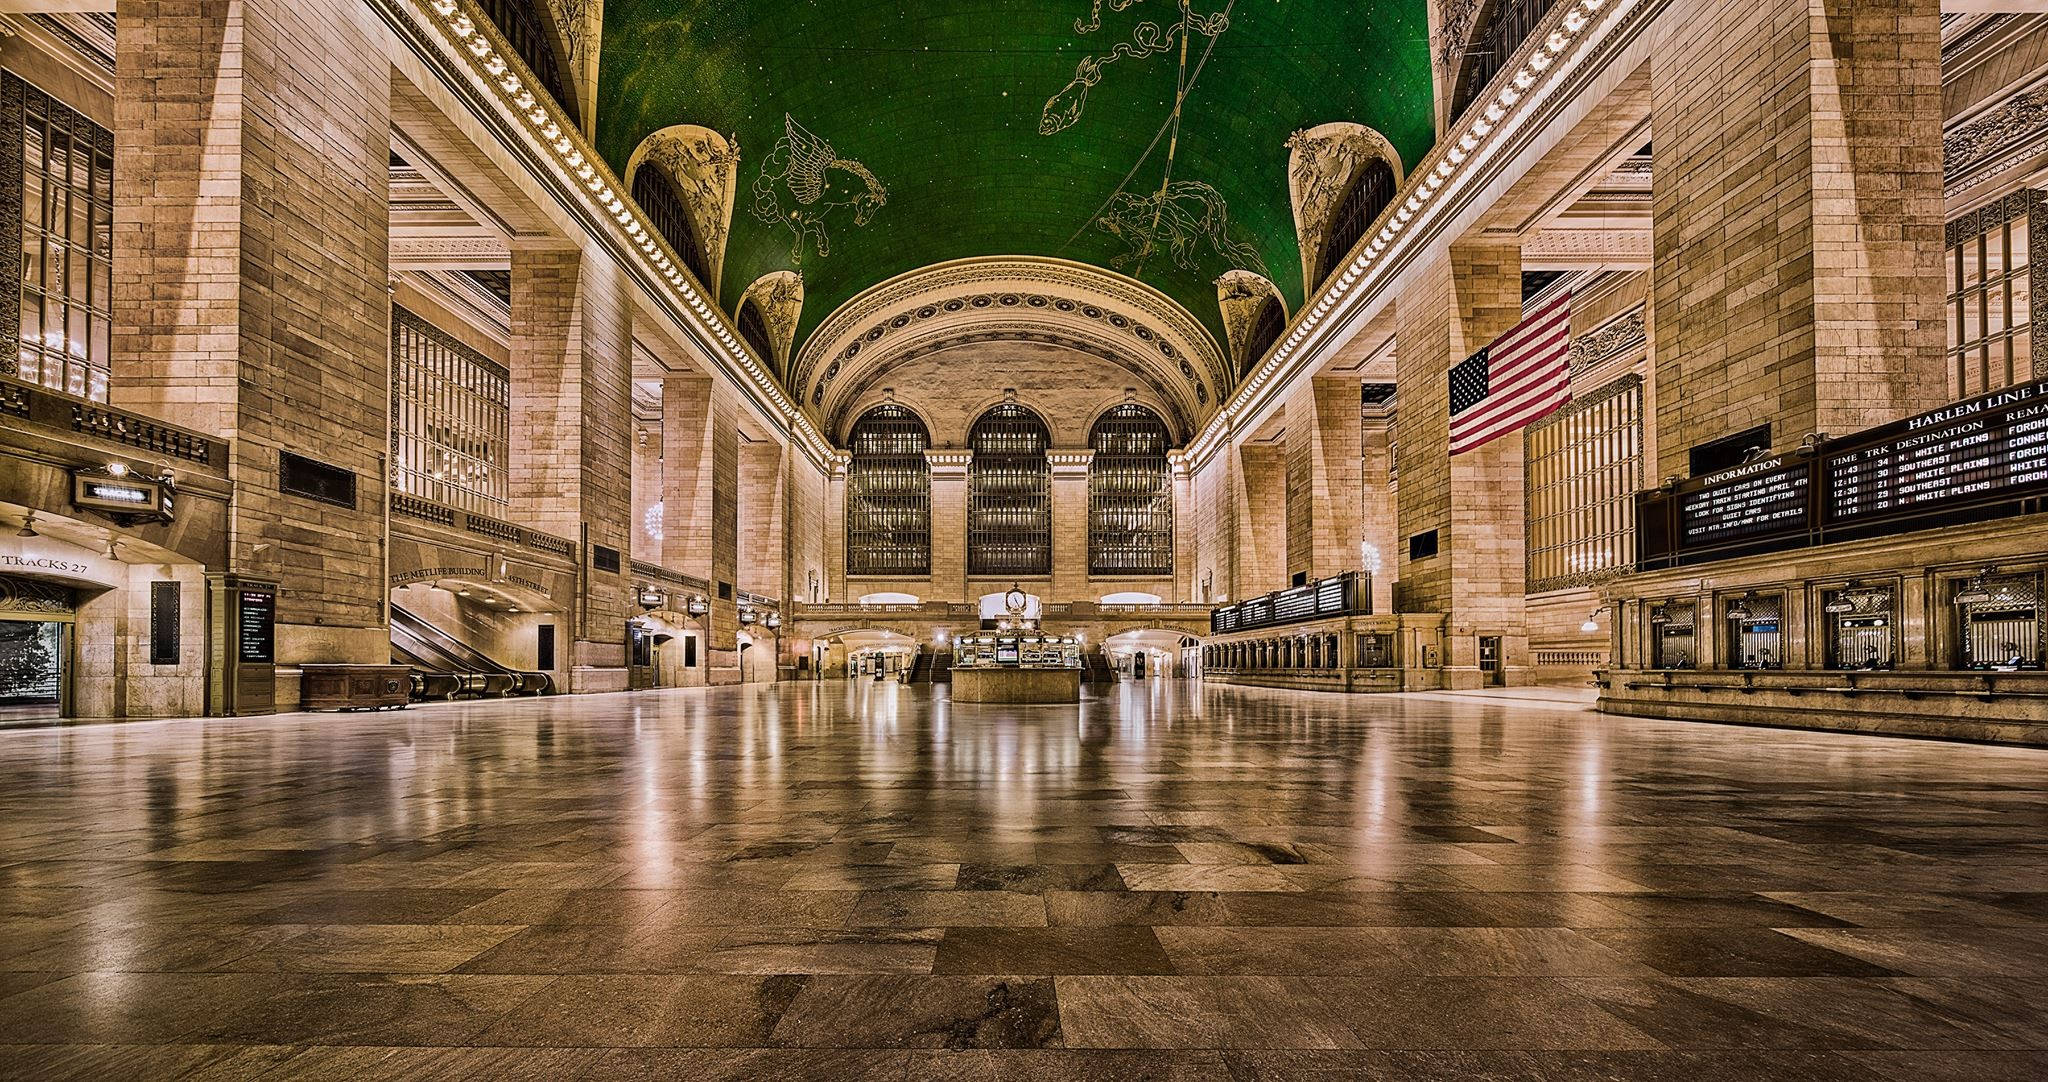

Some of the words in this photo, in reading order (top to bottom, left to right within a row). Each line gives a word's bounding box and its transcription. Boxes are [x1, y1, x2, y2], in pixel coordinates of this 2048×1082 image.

[1908, 401, 1981, 431] HARLEM
[1987, 387, 2032, 409] LINE
[1831, 453, 1858, 467] TIME
[1865, 445, 1889, 459] TRK
[1896, 420, 1984, 451] DESTINATION
[1834, 465, 1858, 477] 11:43
[1877, 458, 1889, 467] 34
[1915, 443, 1945, 458] WHITE
[1950, 433, 1989, 449] PLAINS
[1704, 457, 1782, 486] INFORMATION
[1833, 477, 1858, 488] 12:10
[1877, 469, 1889, 478] 30
[1898, 454, 1951, 473] SOUTHEAST
[2009, 431, 2048, 448] CONNE
[1833, 486, 1858, 498] 12:30
[1877, 479, 1888, 488] 21
[1915, 466, 1946, 480] WHITE
[1950, 457, 1990, 474] PLAINS
[2009, 445, 2048, 461] FORDH
[1684, 501, 1710, 512] WEEKDAY
[1712, 496, 1732, 506] TRAIN
[1734, 488, 1766, 501] STARTING
[1768, 482, 1790, 493] APRIL
[1794, 478, 1808, 487] 4TH
[1698, 492, 1710, 500] TWO
[1712, 487, 1732, 497] QUIET
[1734, 482, 1751, 492] CARS
[1753, 478, 1763, 487] ON
[1765, 473, 1787, 484] EVERY
[1838, 496, 1858, 507] 1:04
[1877, 490, 1889, 499] 29
[1898, 477, 1952, 495] SOUTHEAST
[2010, 457, 2047, 473] WHITE
[1694, 510, 1710, 518] LOOK
[1712, 507, 1724, 515] FOR
[1726, 502, 1746, 512] SIGNS
[1749, 490, 1795, 506] IDENTIFYING
[1722, 511, 1741, 521] QUIET
[1744, 507, 1762, 516] CARS
[1838, 506, 1858, 517] 1:15
[1877, 500, 1889, 509] 20
[1915, 488, 1946, 502] WHITE
[1951, 481, 1991, 495] PLAINS
[1688, 526, 1706, 535] VISIT
[1756, 513, 1769, 522] FOR
[1772, 507, 1803, 519] DETAILS
[1, 555, 68, 571] TRACKS
[71, 563, 88, 574] 27
[390, 572, 410, 583] THE
[410, 567, 448, 578] METLIFE
[449, 567, 486, 576] BUILDING
[525, 580, 549, 594] STREET
